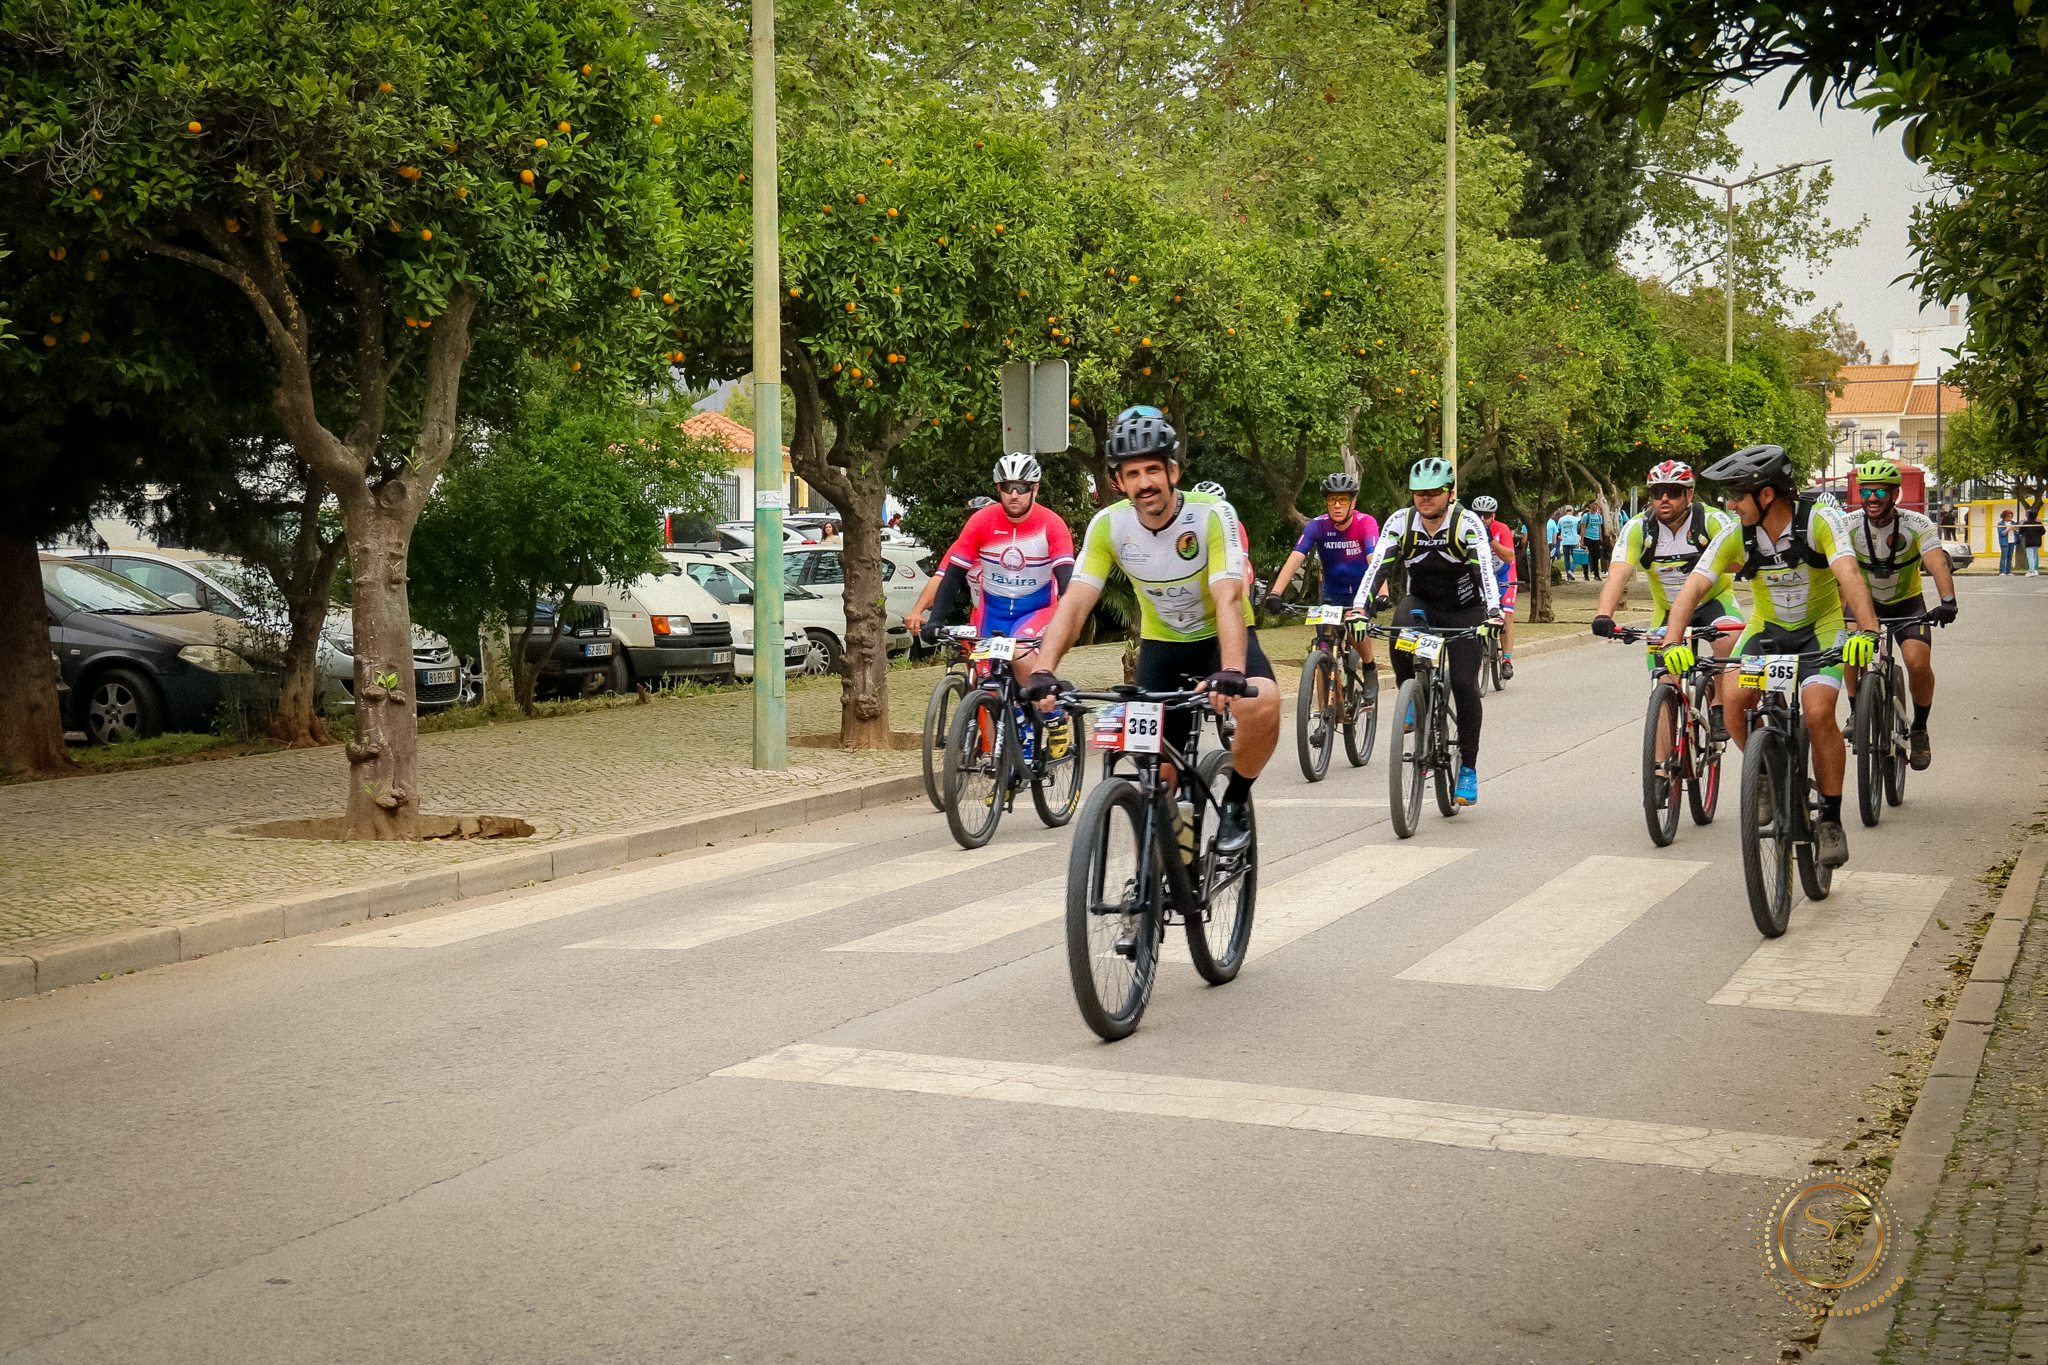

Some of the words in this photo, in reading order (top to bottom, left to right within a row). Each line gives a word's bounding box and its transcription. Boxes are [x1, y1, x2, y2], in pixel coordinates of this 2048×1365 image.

[1346, 547, 1362, 556] BIKE
[991, 572, 1038, 586] tavira
[1782, 571, 1802, 582] CA
[1166, 587, 1193, 598] CA
[1324, 610, 1339, 619] 376
[993, 643, 1010, 653] 318
[1420, 637, 1438, 649] 375
[1768, 665, 1794, 680] 365
[1128, 717, 1158, 736] 368
